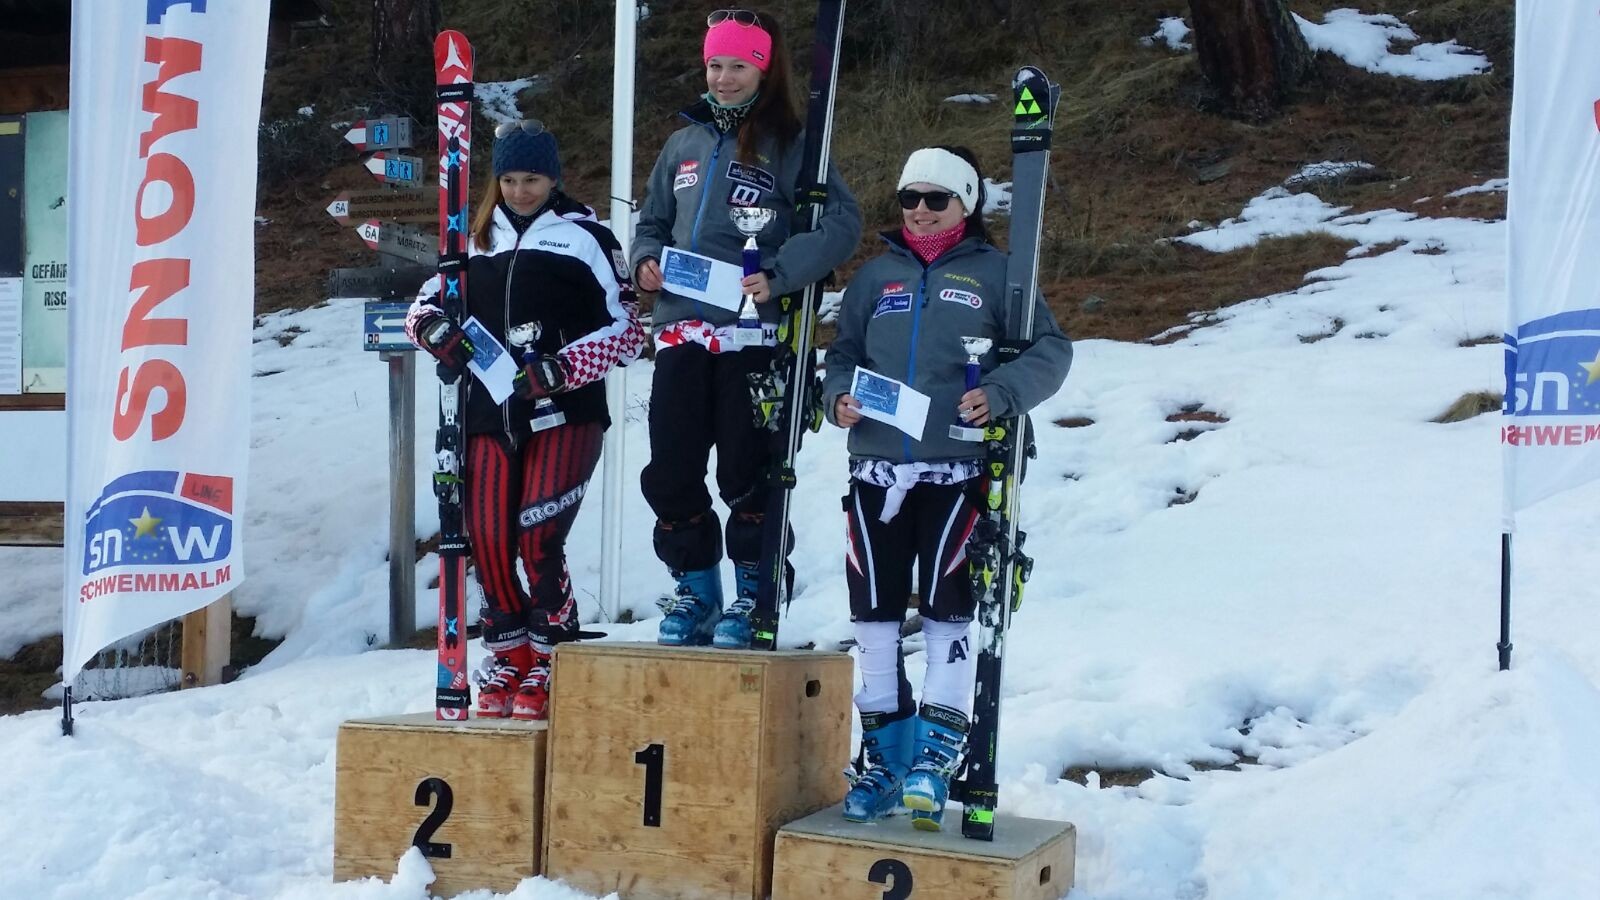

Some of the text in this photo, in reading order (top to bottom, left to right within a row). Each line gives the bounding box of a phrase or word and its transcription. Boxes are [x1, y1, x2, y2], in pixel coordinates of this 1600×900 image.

[335, 203, 346, 214] 6A
[364, 226, 377, 240] 6A
[80, 564, 231, 603] SCHWEMMALM
[497, 627, 526, 641] ATOMIC
[528, 631, 548, 644] TOMIC
[635, 743, 664, 827] 1
[413, 777, 453, 858] 2
